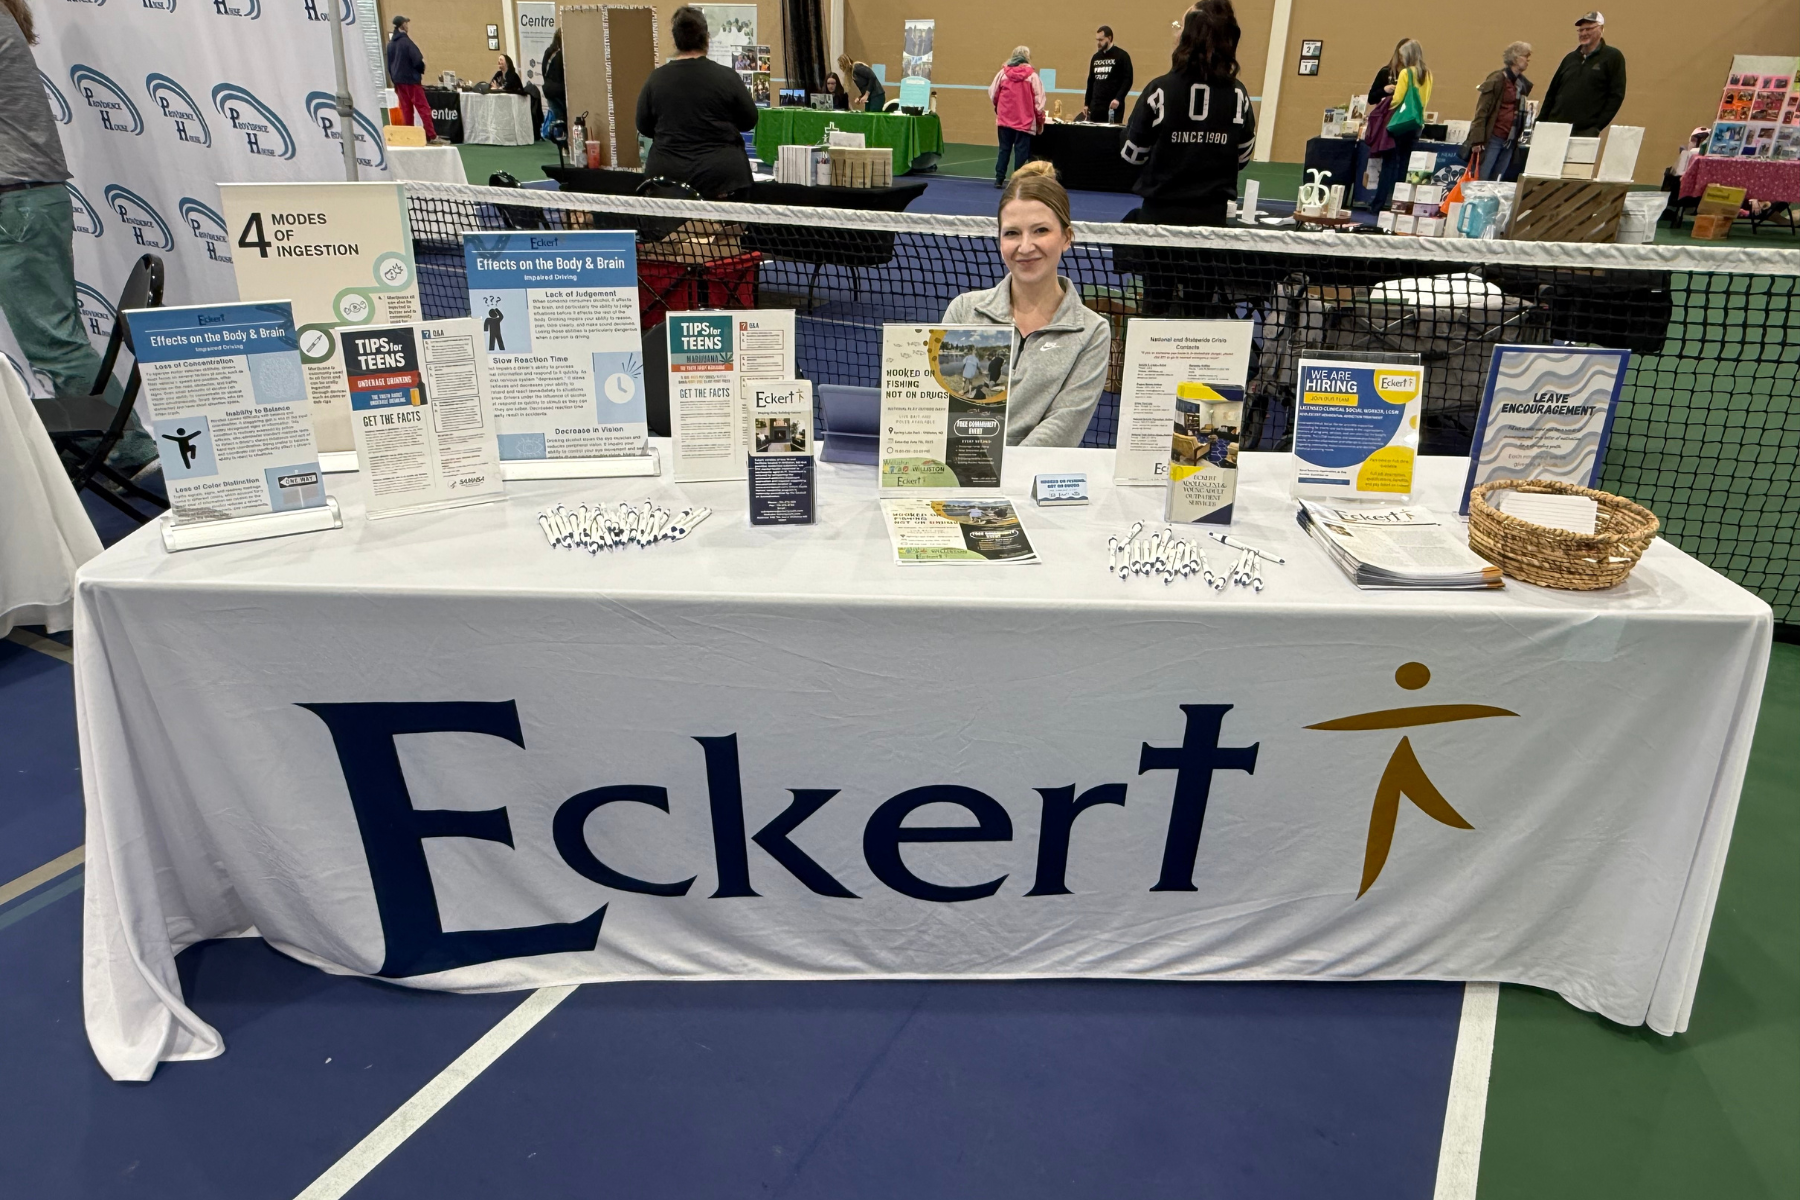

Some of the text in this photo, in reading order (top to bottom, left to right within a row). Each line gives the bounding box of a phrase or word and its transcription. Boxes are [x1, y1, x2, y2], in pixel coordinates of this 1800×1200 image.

[520, 14, 555, 28] Centre
[431, 107, 459, 121] entre
[1171, 131, 1229, 145] SINCE 1980
[271, 213, 328, 226] MODES
[237, 212, 273, 259] 4
[274, 229, 295, 242] OF
[276, 243, 360, 257] INGESTION
[530, 237, 559, 250] Eckert
[477, 256, 625, 272] Effects on the Body & Brain
[554, 273, 578, 281] Driving
[545, 289, 617, 299] Lack of Judgement
[432, 329, 445, 338] Q&A
[681, 322, 710, 336] TIPS
[150, 326, 285, 347] Effects on the Body & Brain
[194, 343, 244, 353] Impaired Driving
[355, 336, 403, 354] TIPS for
[681, 337, 722, 350] TEENS
[154, 357, 235, 370] Loss of Concentration
[358, 352, 406, 370] TEENS
[493, 357, 513, 365] Slow
[514, 355, 549, 363] Reaction
[686, 354, 719, 364] MARIJUANA
[886, 367, 936, 378] HOOKED ON
[1311, 369, 1352, 381] WE ARE
[357, 375, 413, 388] UNDERAGE DRINKING
[886, 380, 920, 388] FISHING
[1305, 378, 1358, 393] HIRING
[1381, 376, 1407, 390] Eckert
[679, 387, 730, 399] GET THE FACTS
[755, 390, 795, 408] Eckert
[885, 390, 949, 399] NOT ON DRUGS
[1533, 392, 1570, 404] LEAVE
[225, 405, 291, 418] Inability to Balance
[1500, 403, 1597, 417] ENCOURAGEMENT
[362, 410, 422, 427] GET THE FACTS
[174, 477, 260, 494] Loss of Color Distinction
[285, 475, 314, 485] ONE WAY
[897, 476, 921, 487] Eckert
[1333, 508, 1401, 523] Eckert
[291, 698, 1261, 979] Eckert
